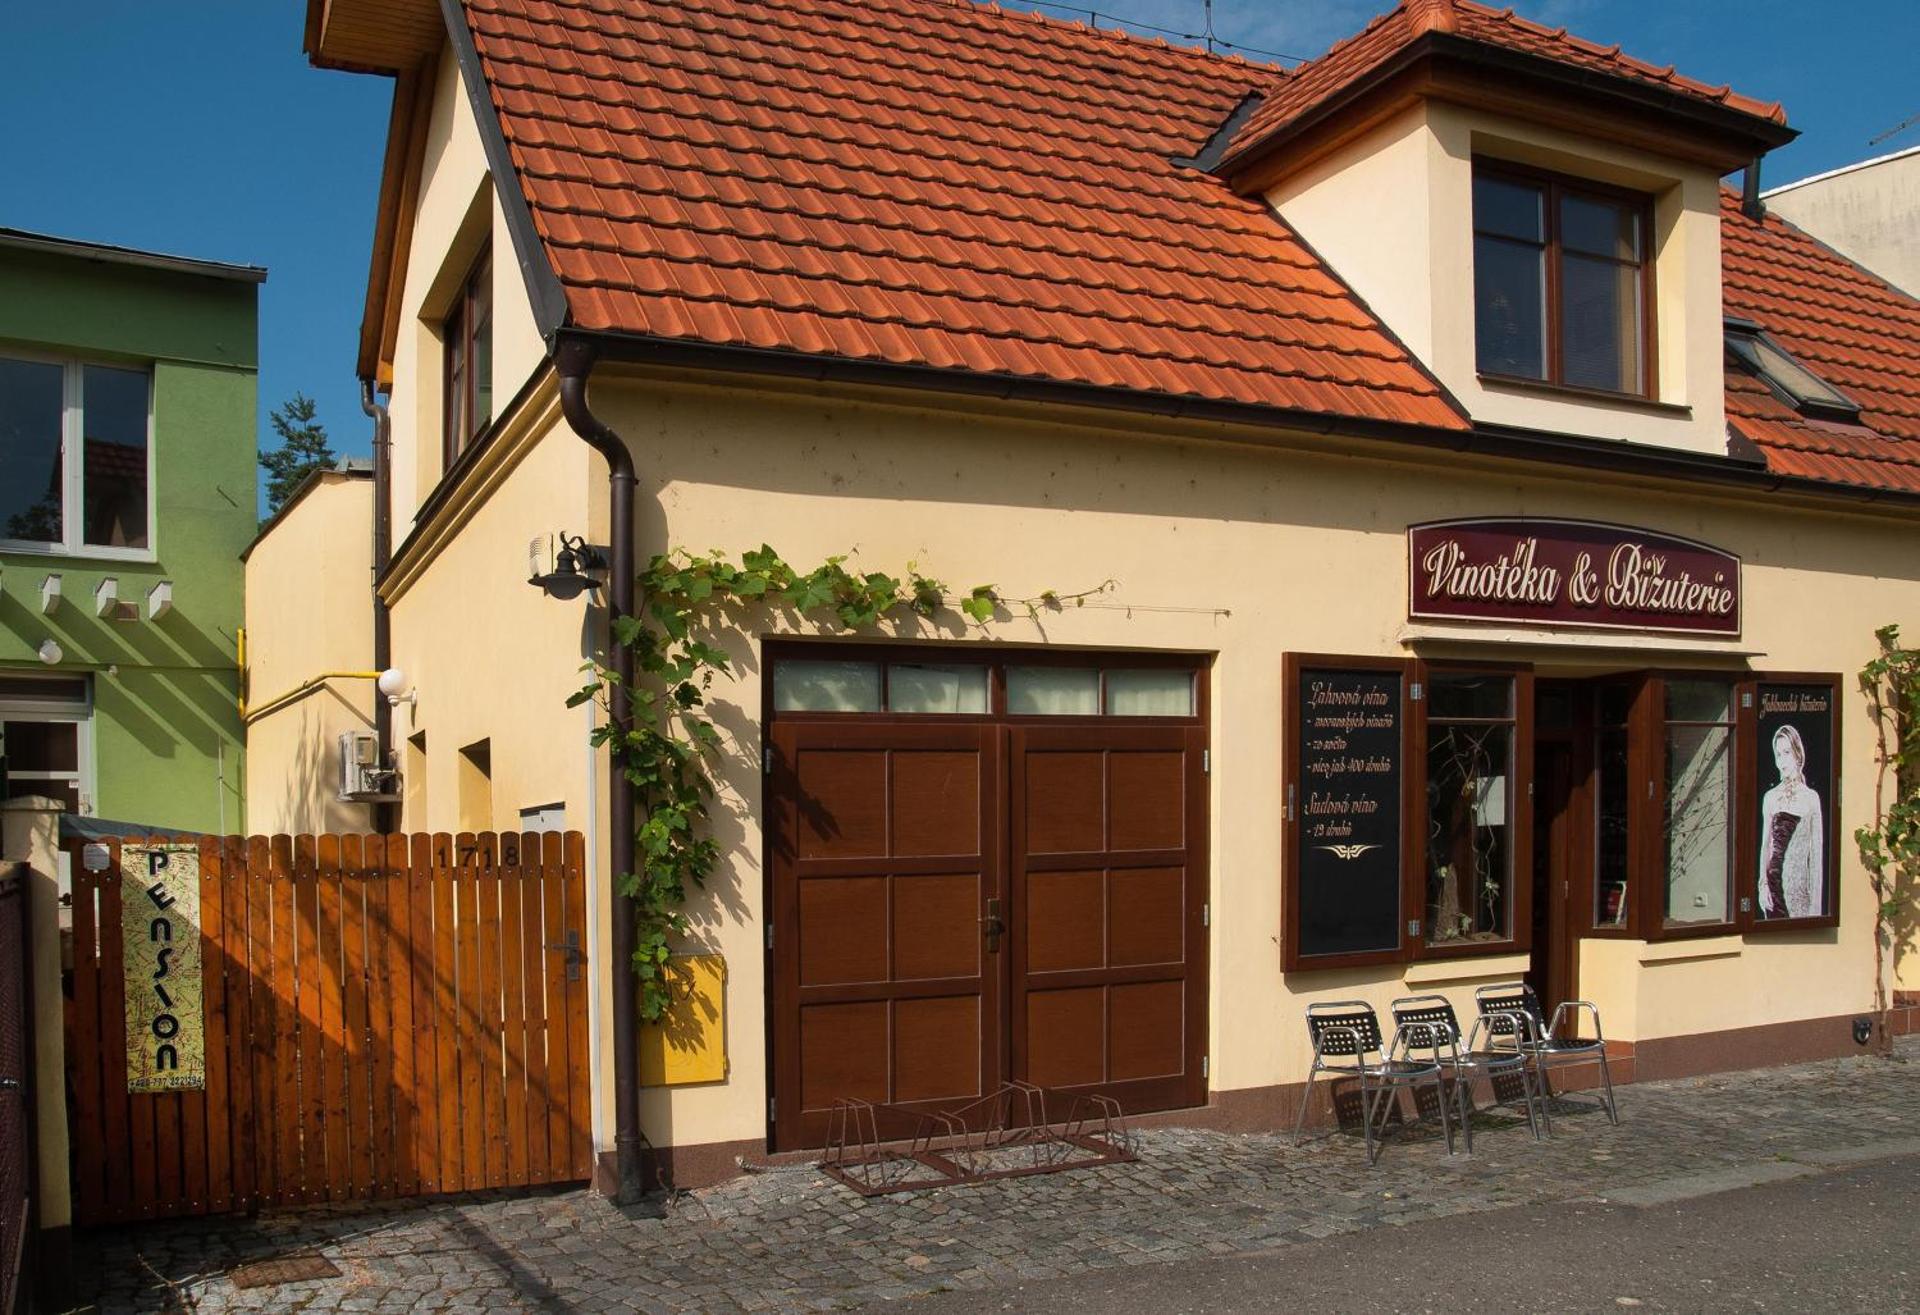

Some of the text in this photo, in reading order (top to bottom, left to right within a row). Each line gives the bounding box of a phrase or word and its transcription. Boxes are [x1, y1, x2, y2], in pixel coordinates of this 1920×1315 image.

[1423, 537, 1736, 614] Vinotéka & Bižuterie
[1307, 682, 1389, 709] Lahvová vína
[1352, 793, 1378, 814] vína
[437, 846, 519, 870] 1718
